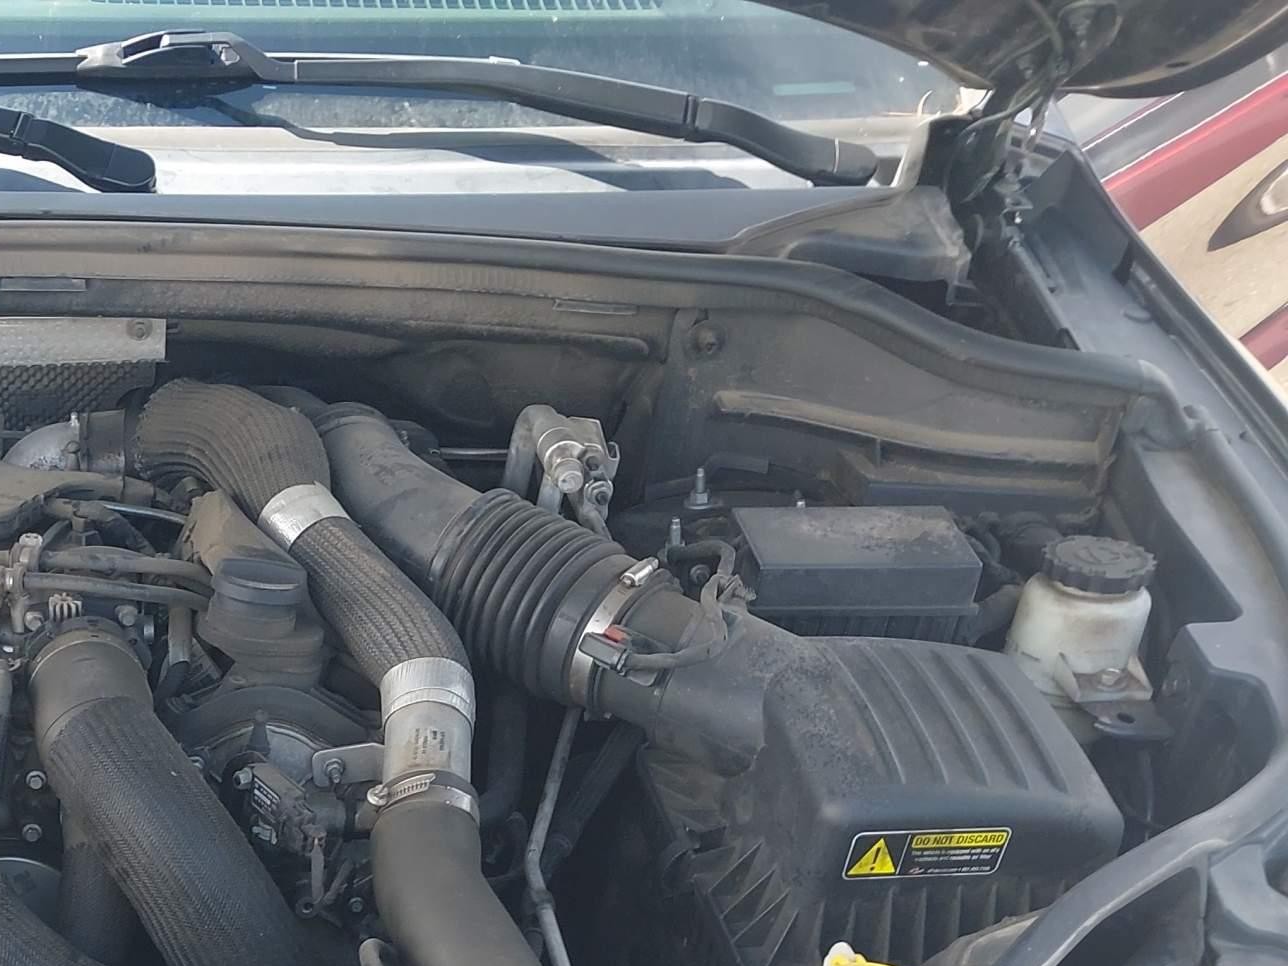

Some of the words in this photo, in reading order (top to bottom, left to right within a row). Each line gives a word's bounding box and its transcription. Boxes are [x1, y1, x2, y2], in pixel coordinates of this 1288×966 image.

[915, 836, 931, 846] DO
[932, 835, 954, 845] NOT
[956, 834, 1004, 845] DISCARD
